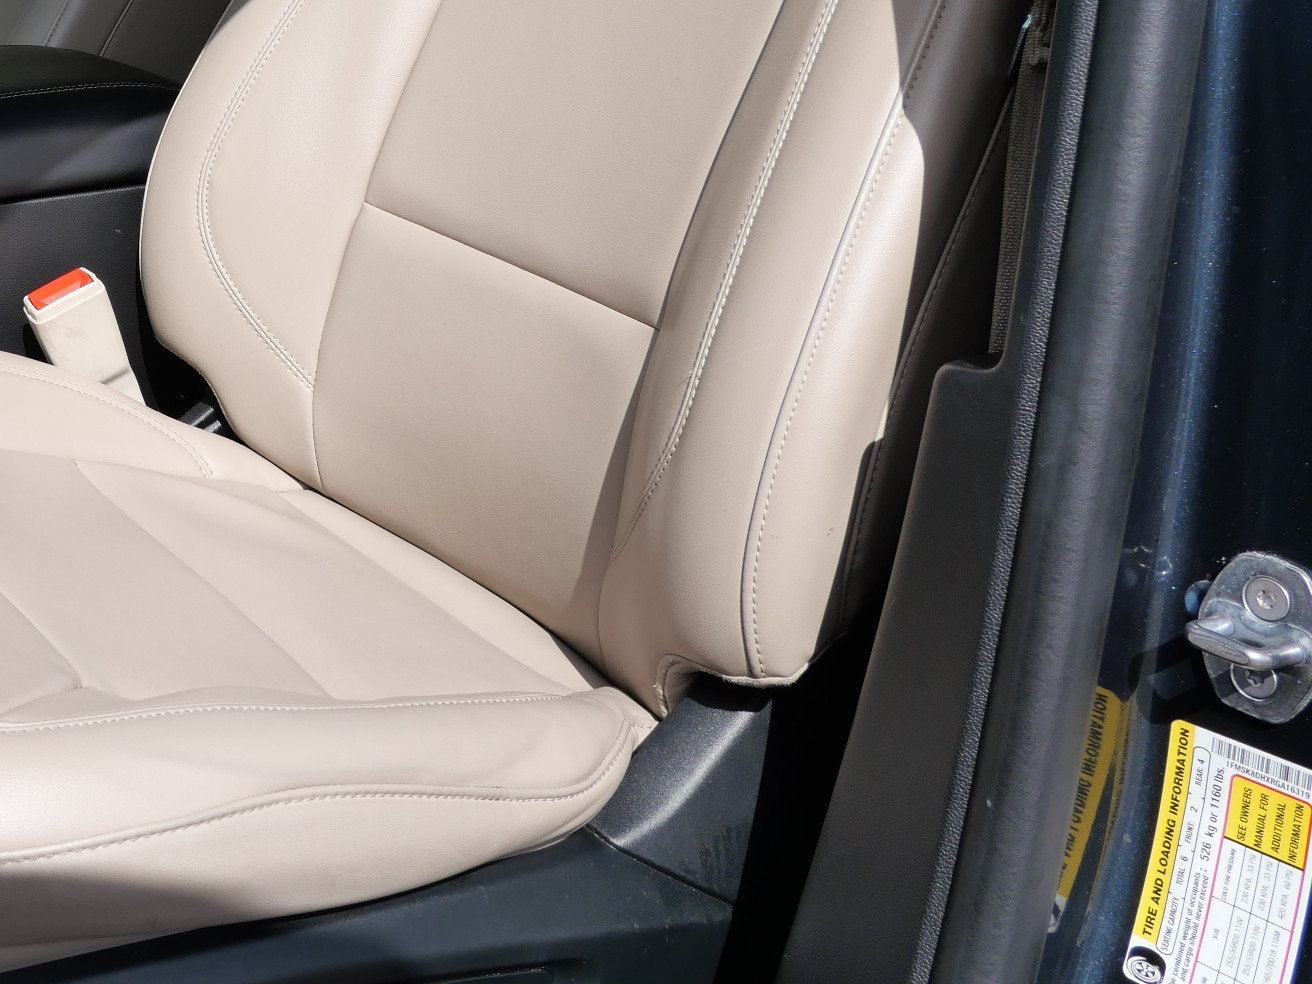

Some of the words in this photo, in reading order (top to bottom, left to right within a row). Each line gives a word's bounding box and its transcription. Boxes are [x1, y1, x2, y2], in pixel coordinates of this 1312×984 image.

[1169, 727, 1189, 816] INFORMATION
[1214, 767, 1225, 783] lbs.
[1210, 784, 1222, 808] 1160
[1240, 787, 1252, 823] OWNERS
[1259, 793, 1269, 811] FOR
[1209, 812, 1218, 822] or
[1271, 803, 1286, 853] ADDITIONAL
[1205, 826, 1217, 837] kg
[1236, 824, 1246, 841] SEE
[1254, 814, 1267, 849] MANUAL
[1288, 803, 1304, 863] INFORMATION
[1157, 819, 1176, 875] LOADING
[1200, 843, 1211, 861] 526
[1152, 878, 1163, 905] AND
[1188, 872, 1201, 907] occupants
[1199, 876, 1209, 900] exceed
[1142, 906, 1157, 936] TIRE
[1185, 908, 1193, 916] of
[1194, 902, 1204, 920] never
[1161, 927, 1172, 951] SEATING
[1168, 896, 1178, 925] CAPACITY
[1180, 917, 1193, 940] weight
[1189, 922, 1200, 946] should
[1172, 942, 1186, 976] combined
[1184, 947, 1194, 967] cargo
[1180, 969, 1188, 981] and
